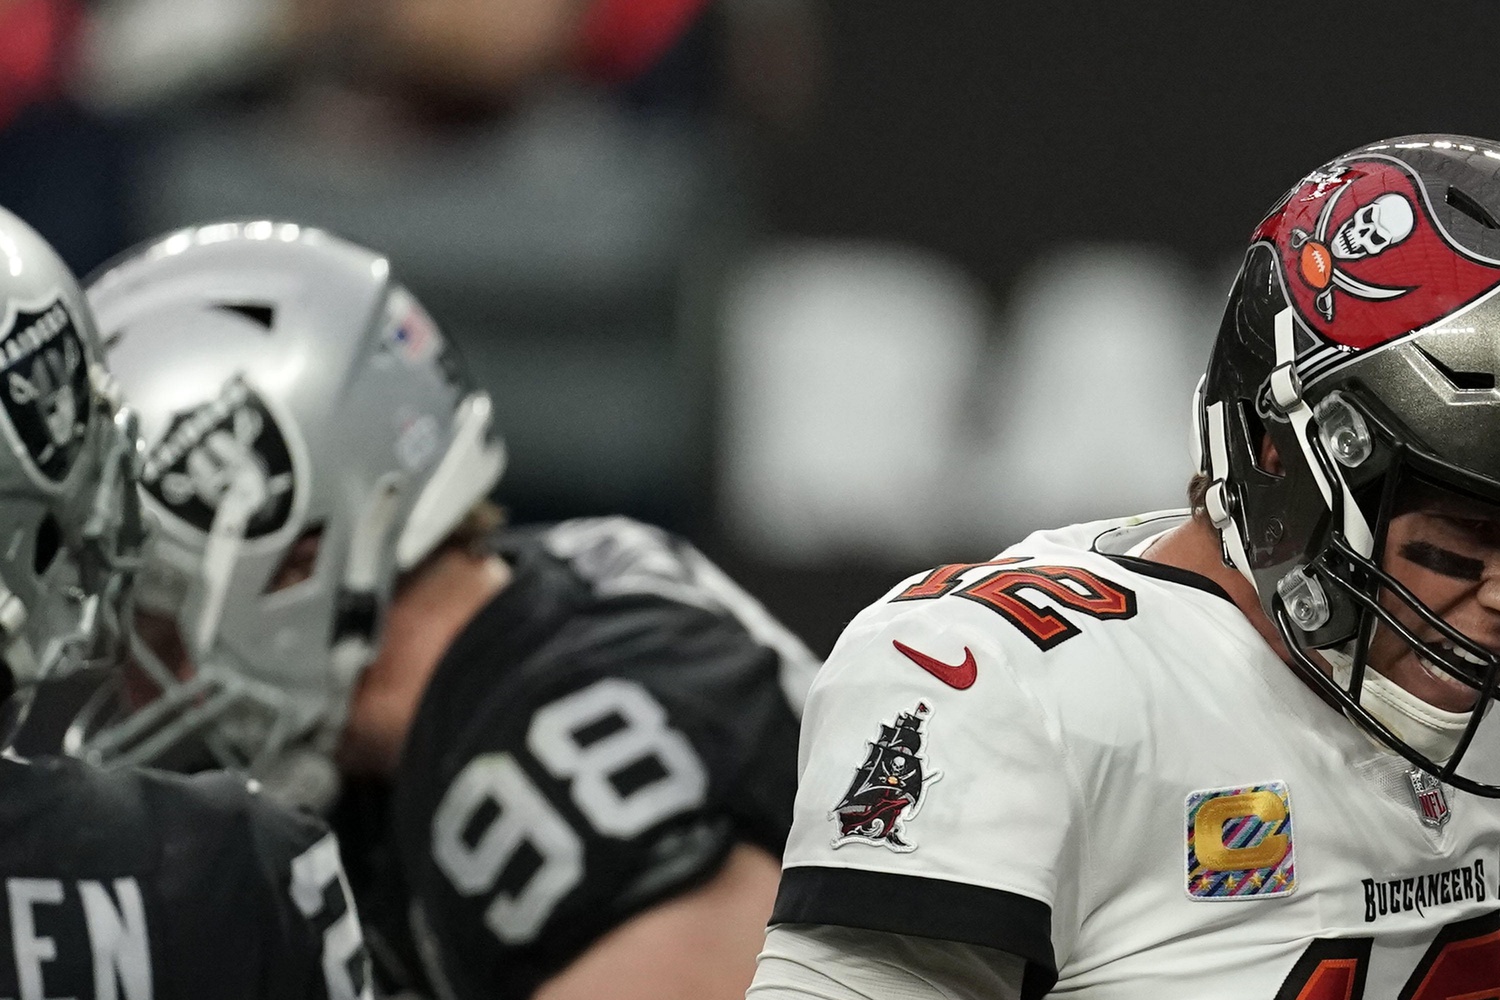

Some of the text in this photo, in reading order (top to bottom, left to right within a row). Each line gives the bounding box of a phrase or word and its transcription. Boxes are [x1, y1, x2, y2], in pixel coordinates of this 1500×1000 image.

[431, 677, 710, 945] 98
[1194, 789, 1289, 872] C
[1418, 789, 1446, 821] NFL
[1361, 858, 1486, 923] BUCCANEERS
